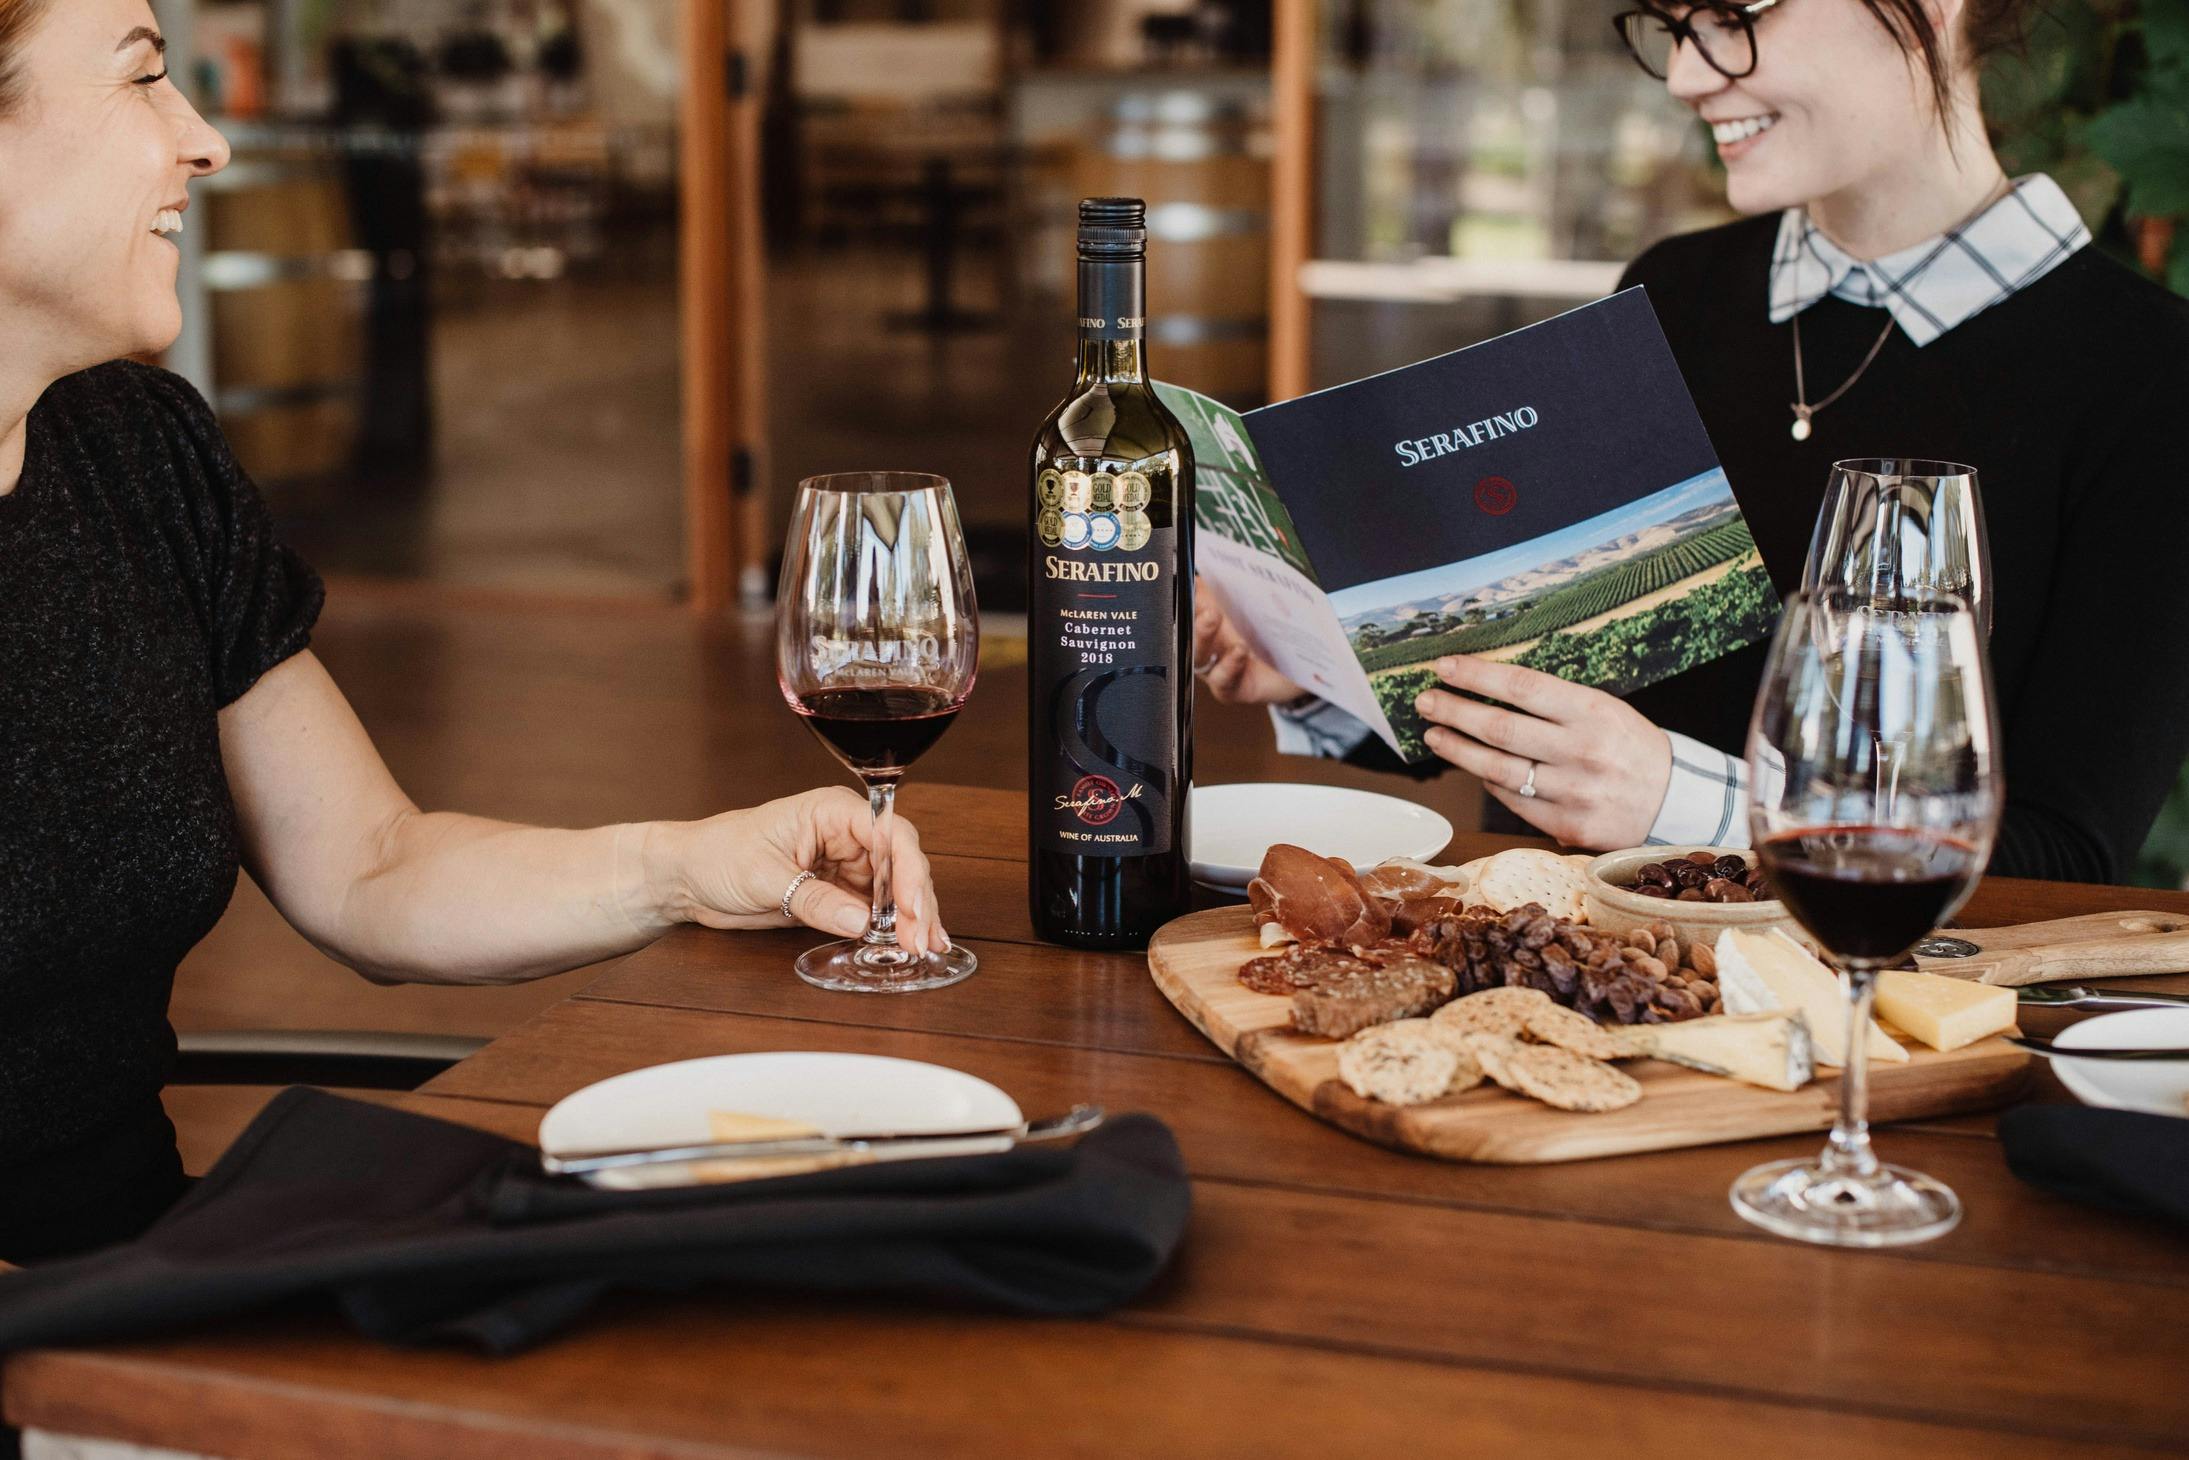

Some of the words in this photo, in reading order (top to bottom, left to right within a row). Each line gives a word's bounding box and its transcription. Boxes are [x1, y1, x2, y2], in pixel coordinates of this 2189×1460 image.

[1394, 406, 1538, 467] SERAFINO
[1093, 482, 1112, 493] GOLD
[1045, 555, 1159, 582] SERAFINO
[1060, 608, 1107, 619] McLAREN
[1110, 611, 1138, 620] VALE
[1064, 621, 1132, 635] Cabernet
[1060, 635, 1136, 652] Sauvignon
[1080, 652, 1114, 664] 2018
[1059, 830, 1079, 841] WINE
[1080, 833, 1093, 842] OF
[1094, 834, 1139, 843] AUSTRALIA
